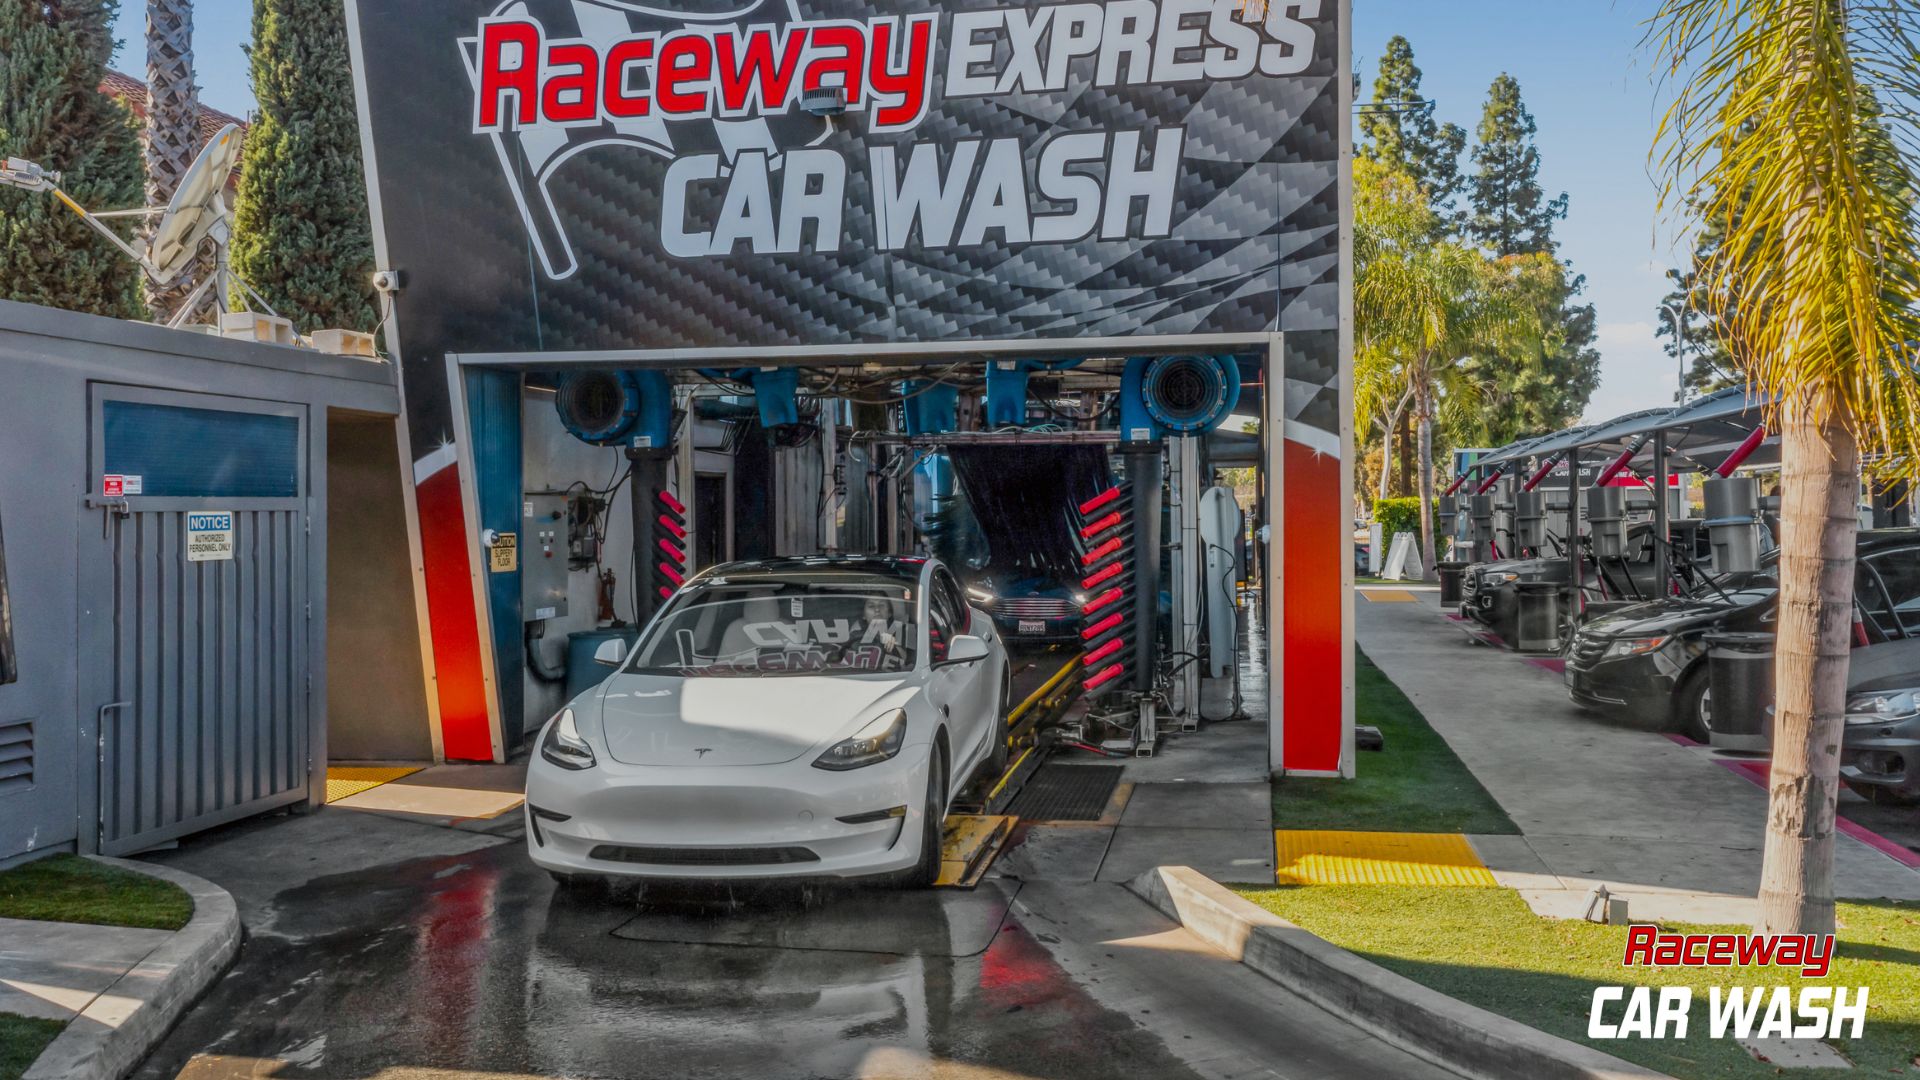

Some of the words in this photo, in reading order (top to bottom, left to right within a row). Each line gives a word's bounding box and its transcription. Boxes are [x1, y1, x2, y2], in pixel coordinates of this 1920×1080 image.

[473, 13, 937, 133] Raceway
[944, 0, 1322, 97] EXPRESS
[660, 147, 847, 257] CAR
[868, 127, 1182, 250] WASH
[191, 516, 229, 529] NOTICE
[195, 534, 225, 543] AUTHORIZED
[189, 543, 218, 552] PERSONNEL
[219, 543, 231, 551] ONLY
[495, 548, 513, 557] SLIPPERY
[497, 557, 511, 567] FLOOR
